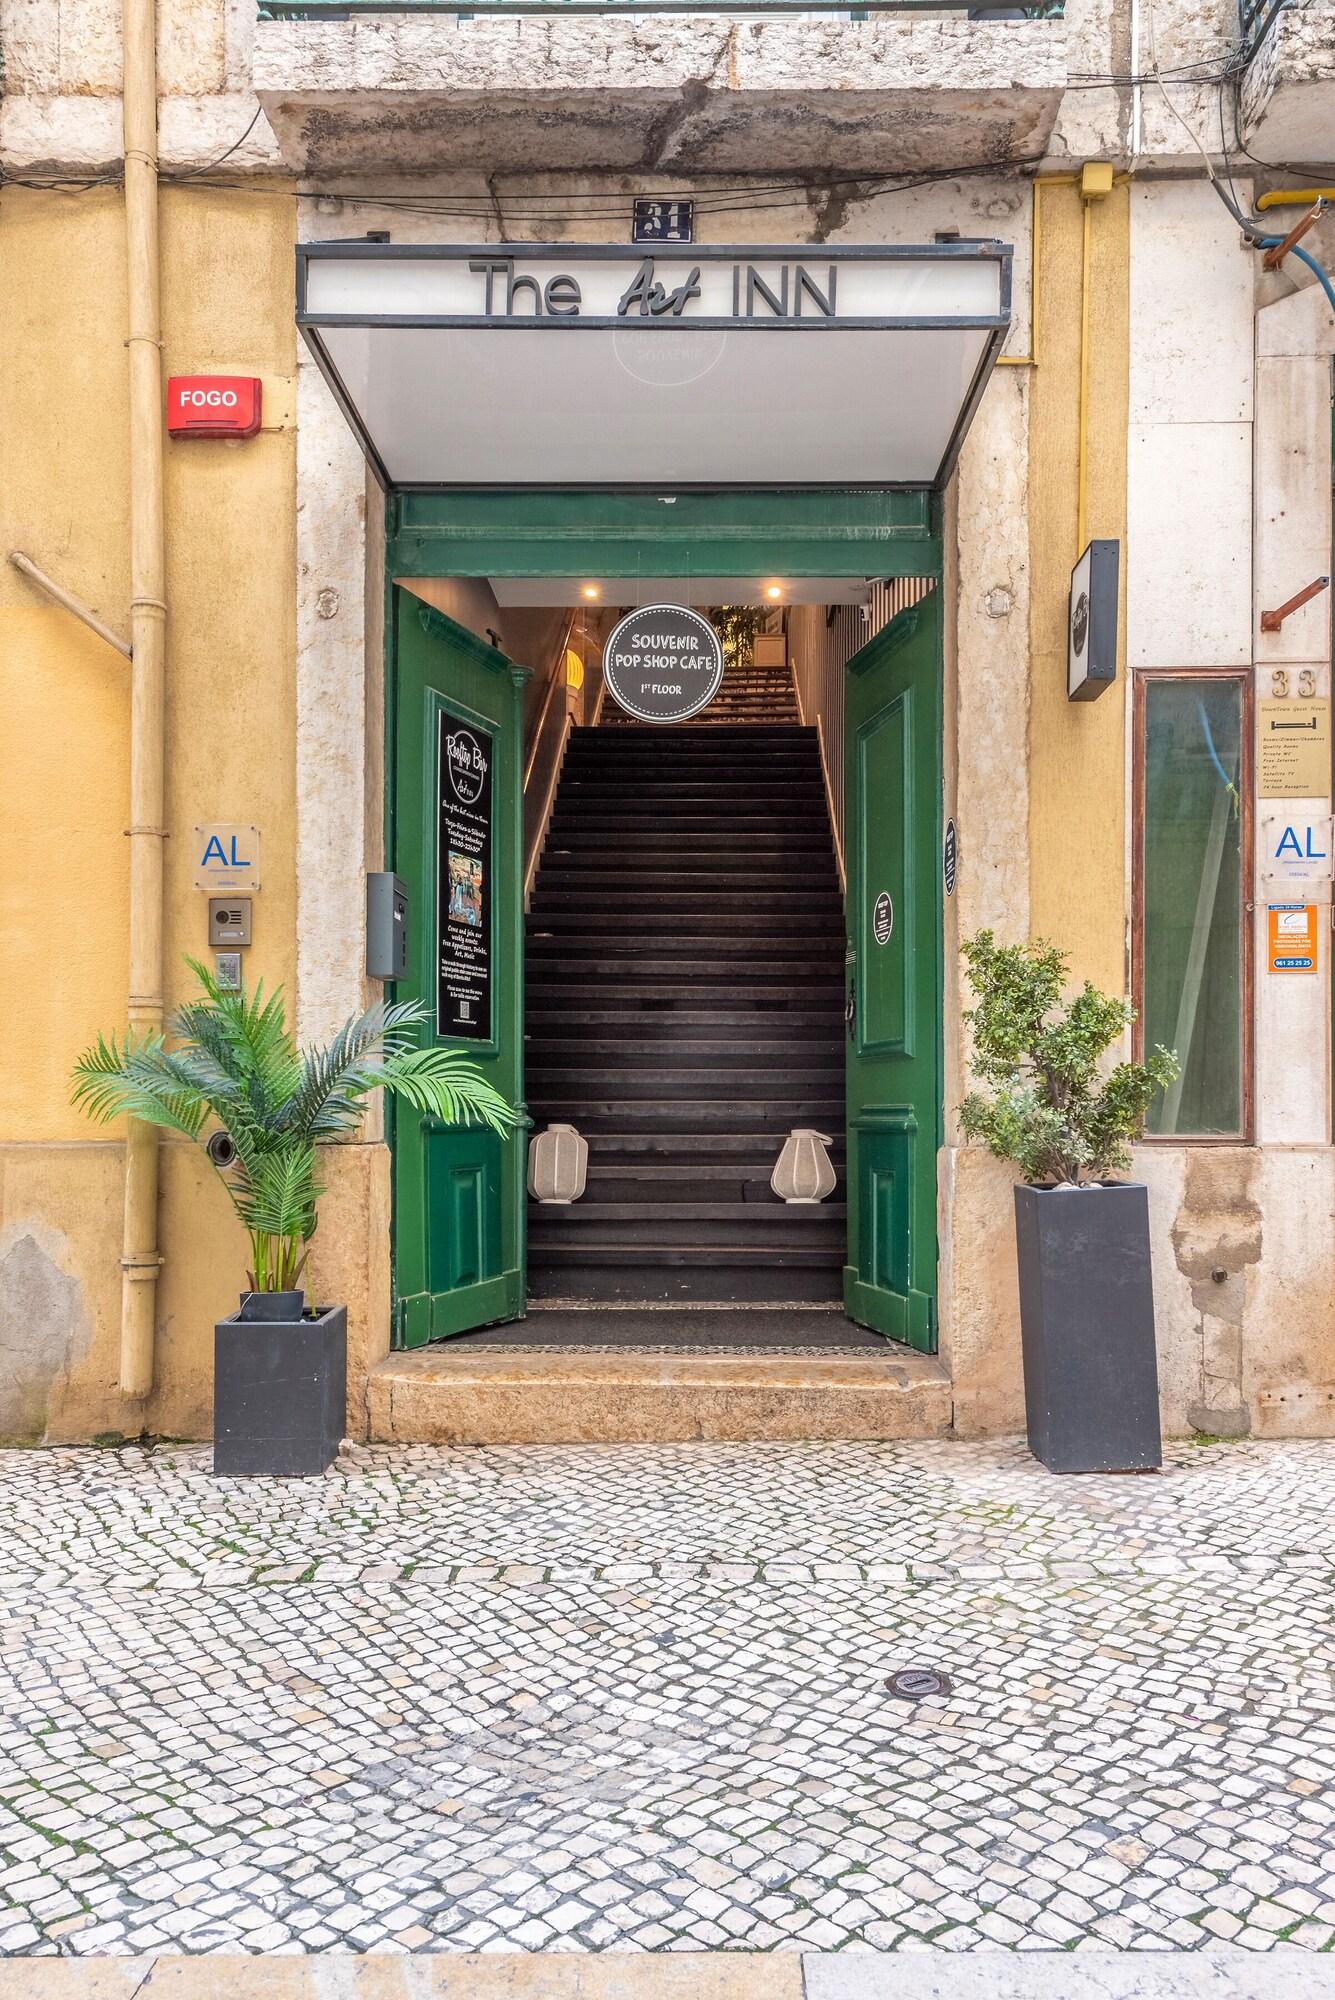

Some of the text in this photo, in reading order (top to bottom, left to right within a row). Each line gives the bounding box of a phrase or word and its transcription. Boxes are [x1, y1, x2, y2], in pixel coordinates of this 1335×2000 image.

[643, 203, 681, 239] 31
[469, 258, 837, 316] The Art INN
[180, 390, 238, 407] FOGO
[631, 634, 699, 650] SOUVENIR
[615, 654, 712, 670] POP SHOP CAFE
[652, 684, 682, 695] FLOOR
[201, 835, 251, 866] AL
[1275, 826, 1326, 858] AL
